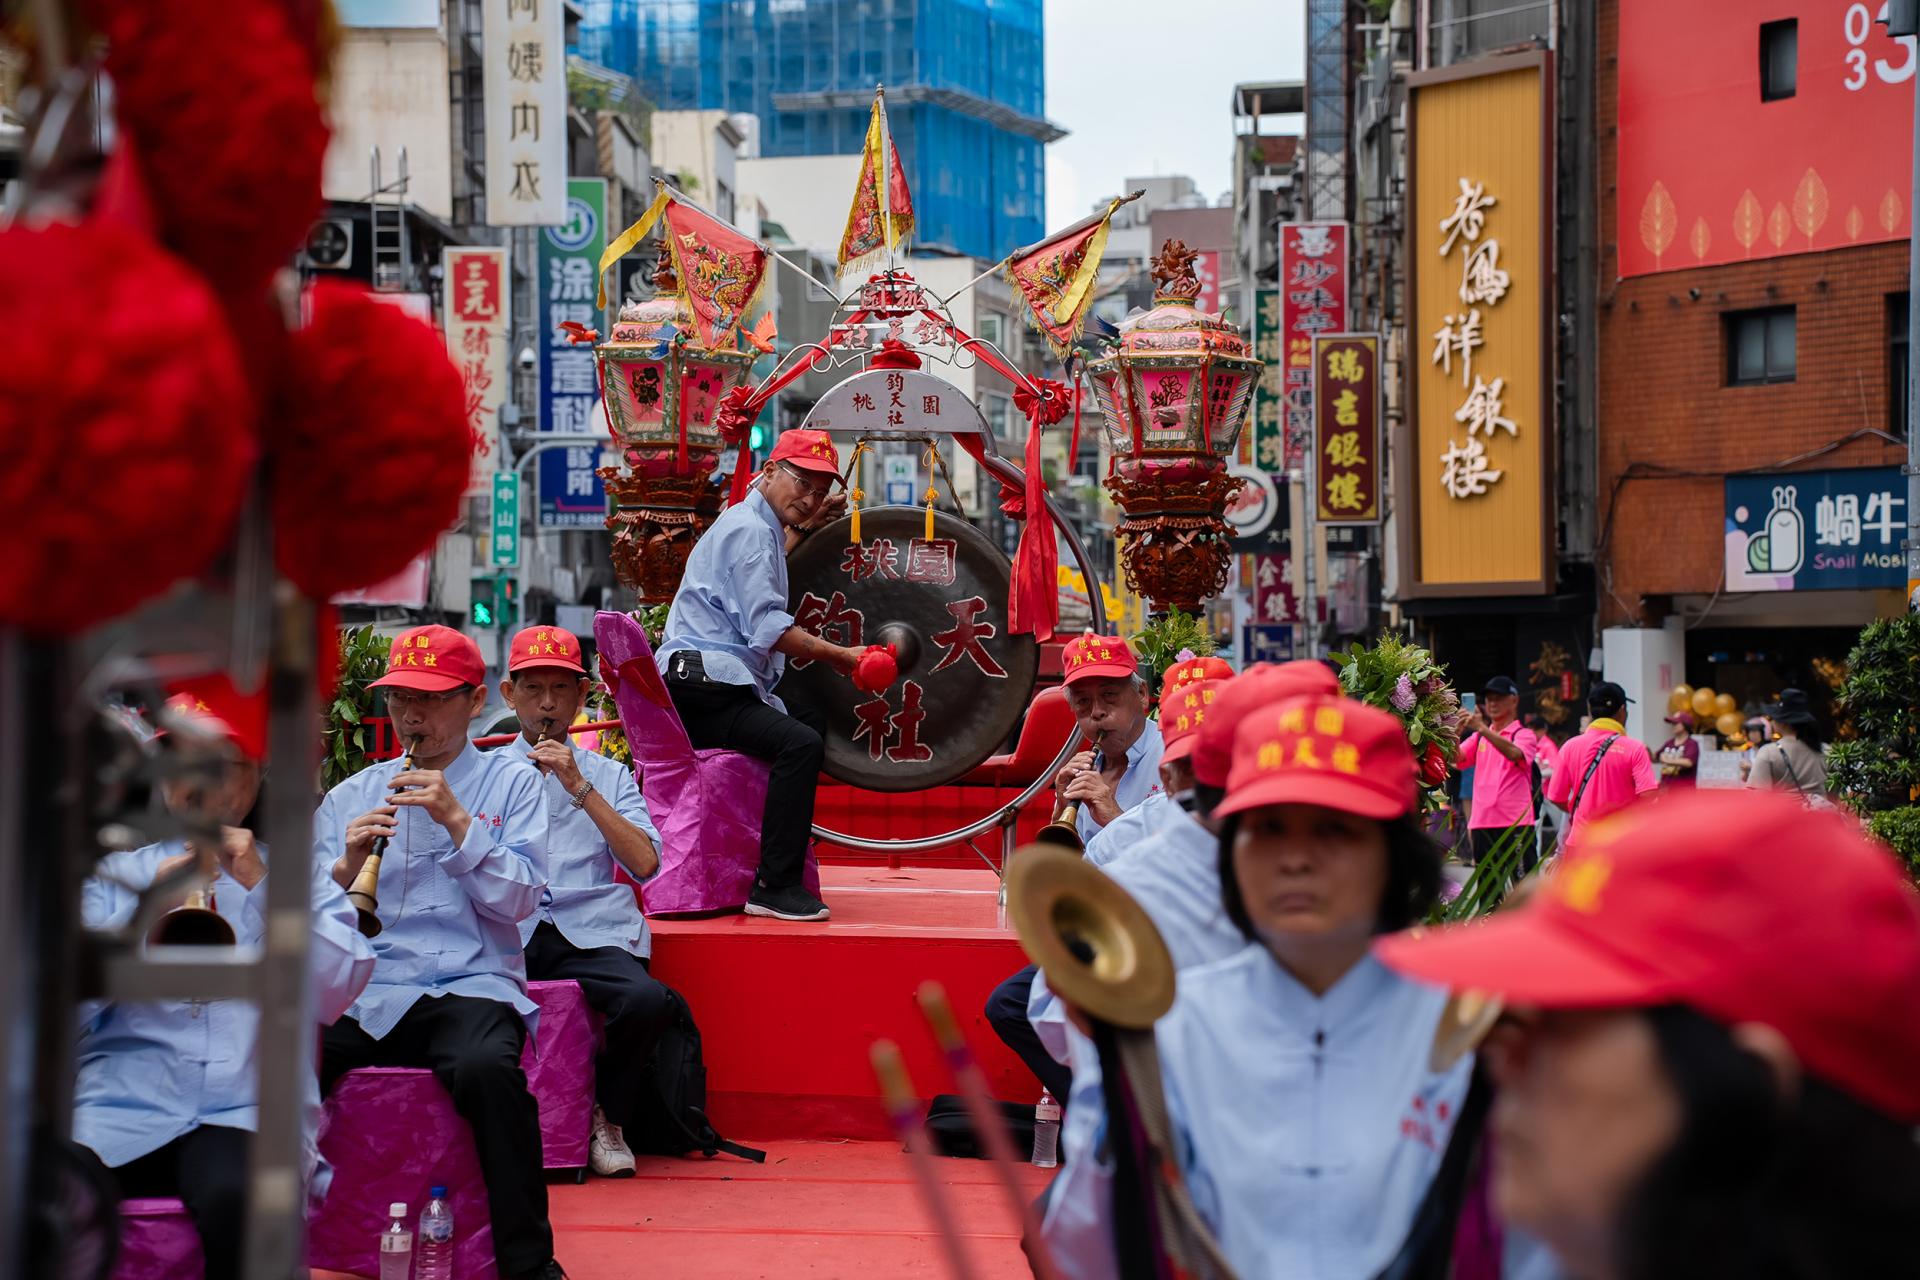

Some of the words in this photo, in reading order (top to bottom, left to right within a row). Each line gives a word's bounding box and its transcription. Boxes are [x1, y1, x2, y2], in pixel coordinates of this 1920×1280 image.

[886, 373, 906, 427] 鈞天社
[1815, 491, 1907, 546] 蝸牛
[840, 538, 957, 586] 桃園
[852, 679, 933, 763] 社
